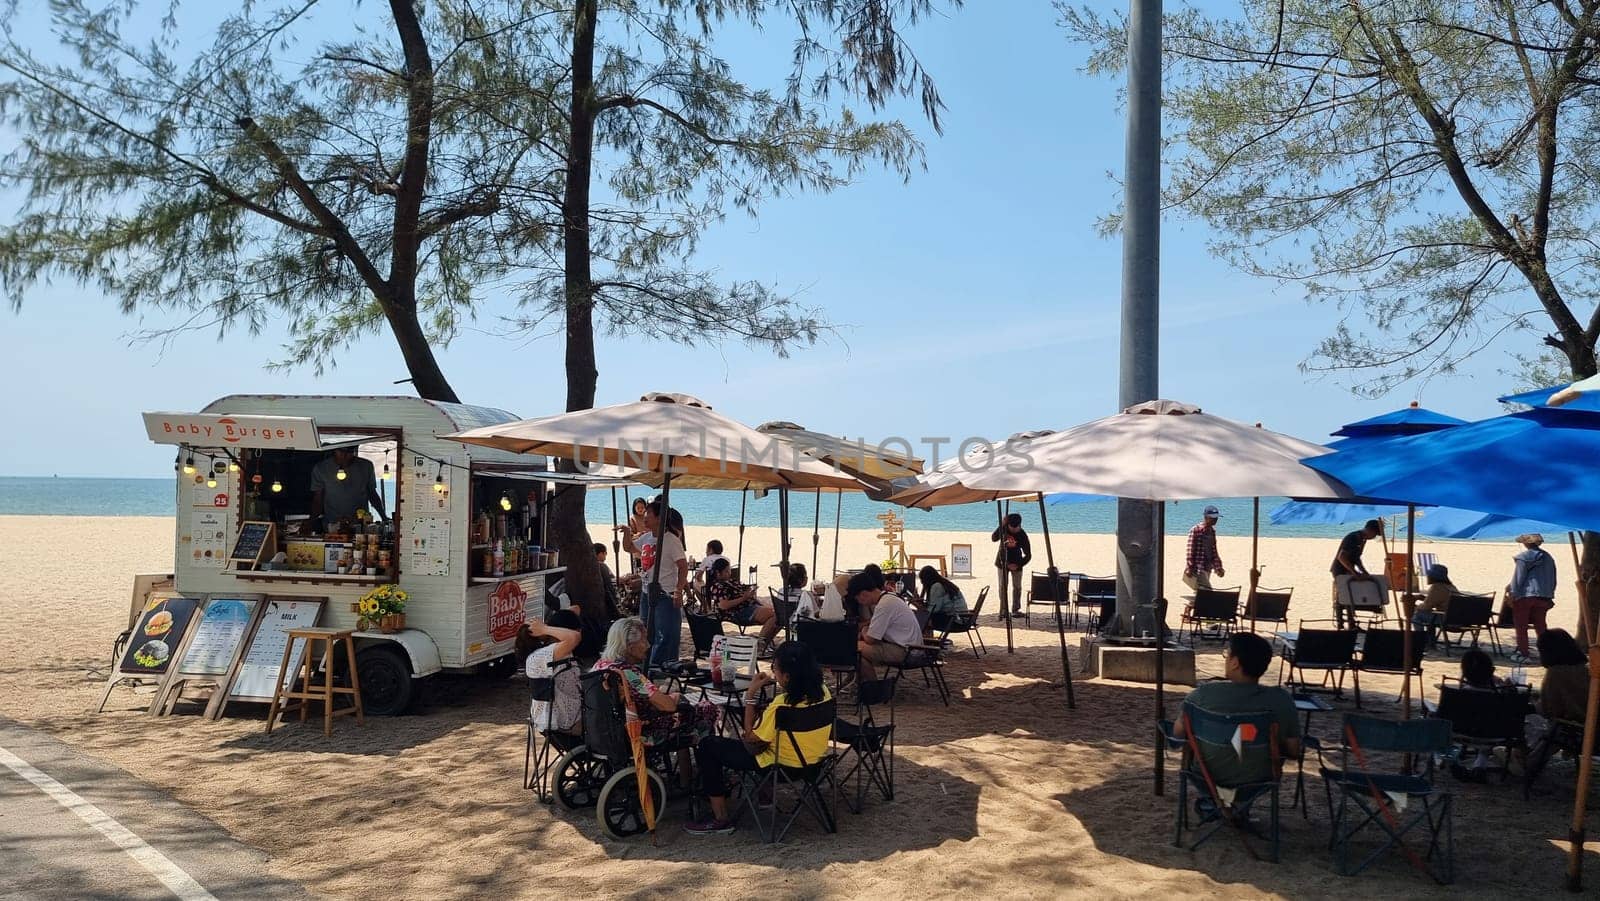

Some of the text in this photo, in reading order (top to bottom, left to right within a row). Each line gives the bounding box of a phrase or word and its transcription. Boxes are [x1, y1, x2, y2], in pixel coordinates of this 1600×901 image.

[163, 422, 296, 440] Baby Burger
[490, 592, 527, 617] Baby
[489, 611, 526, 632] Burger
